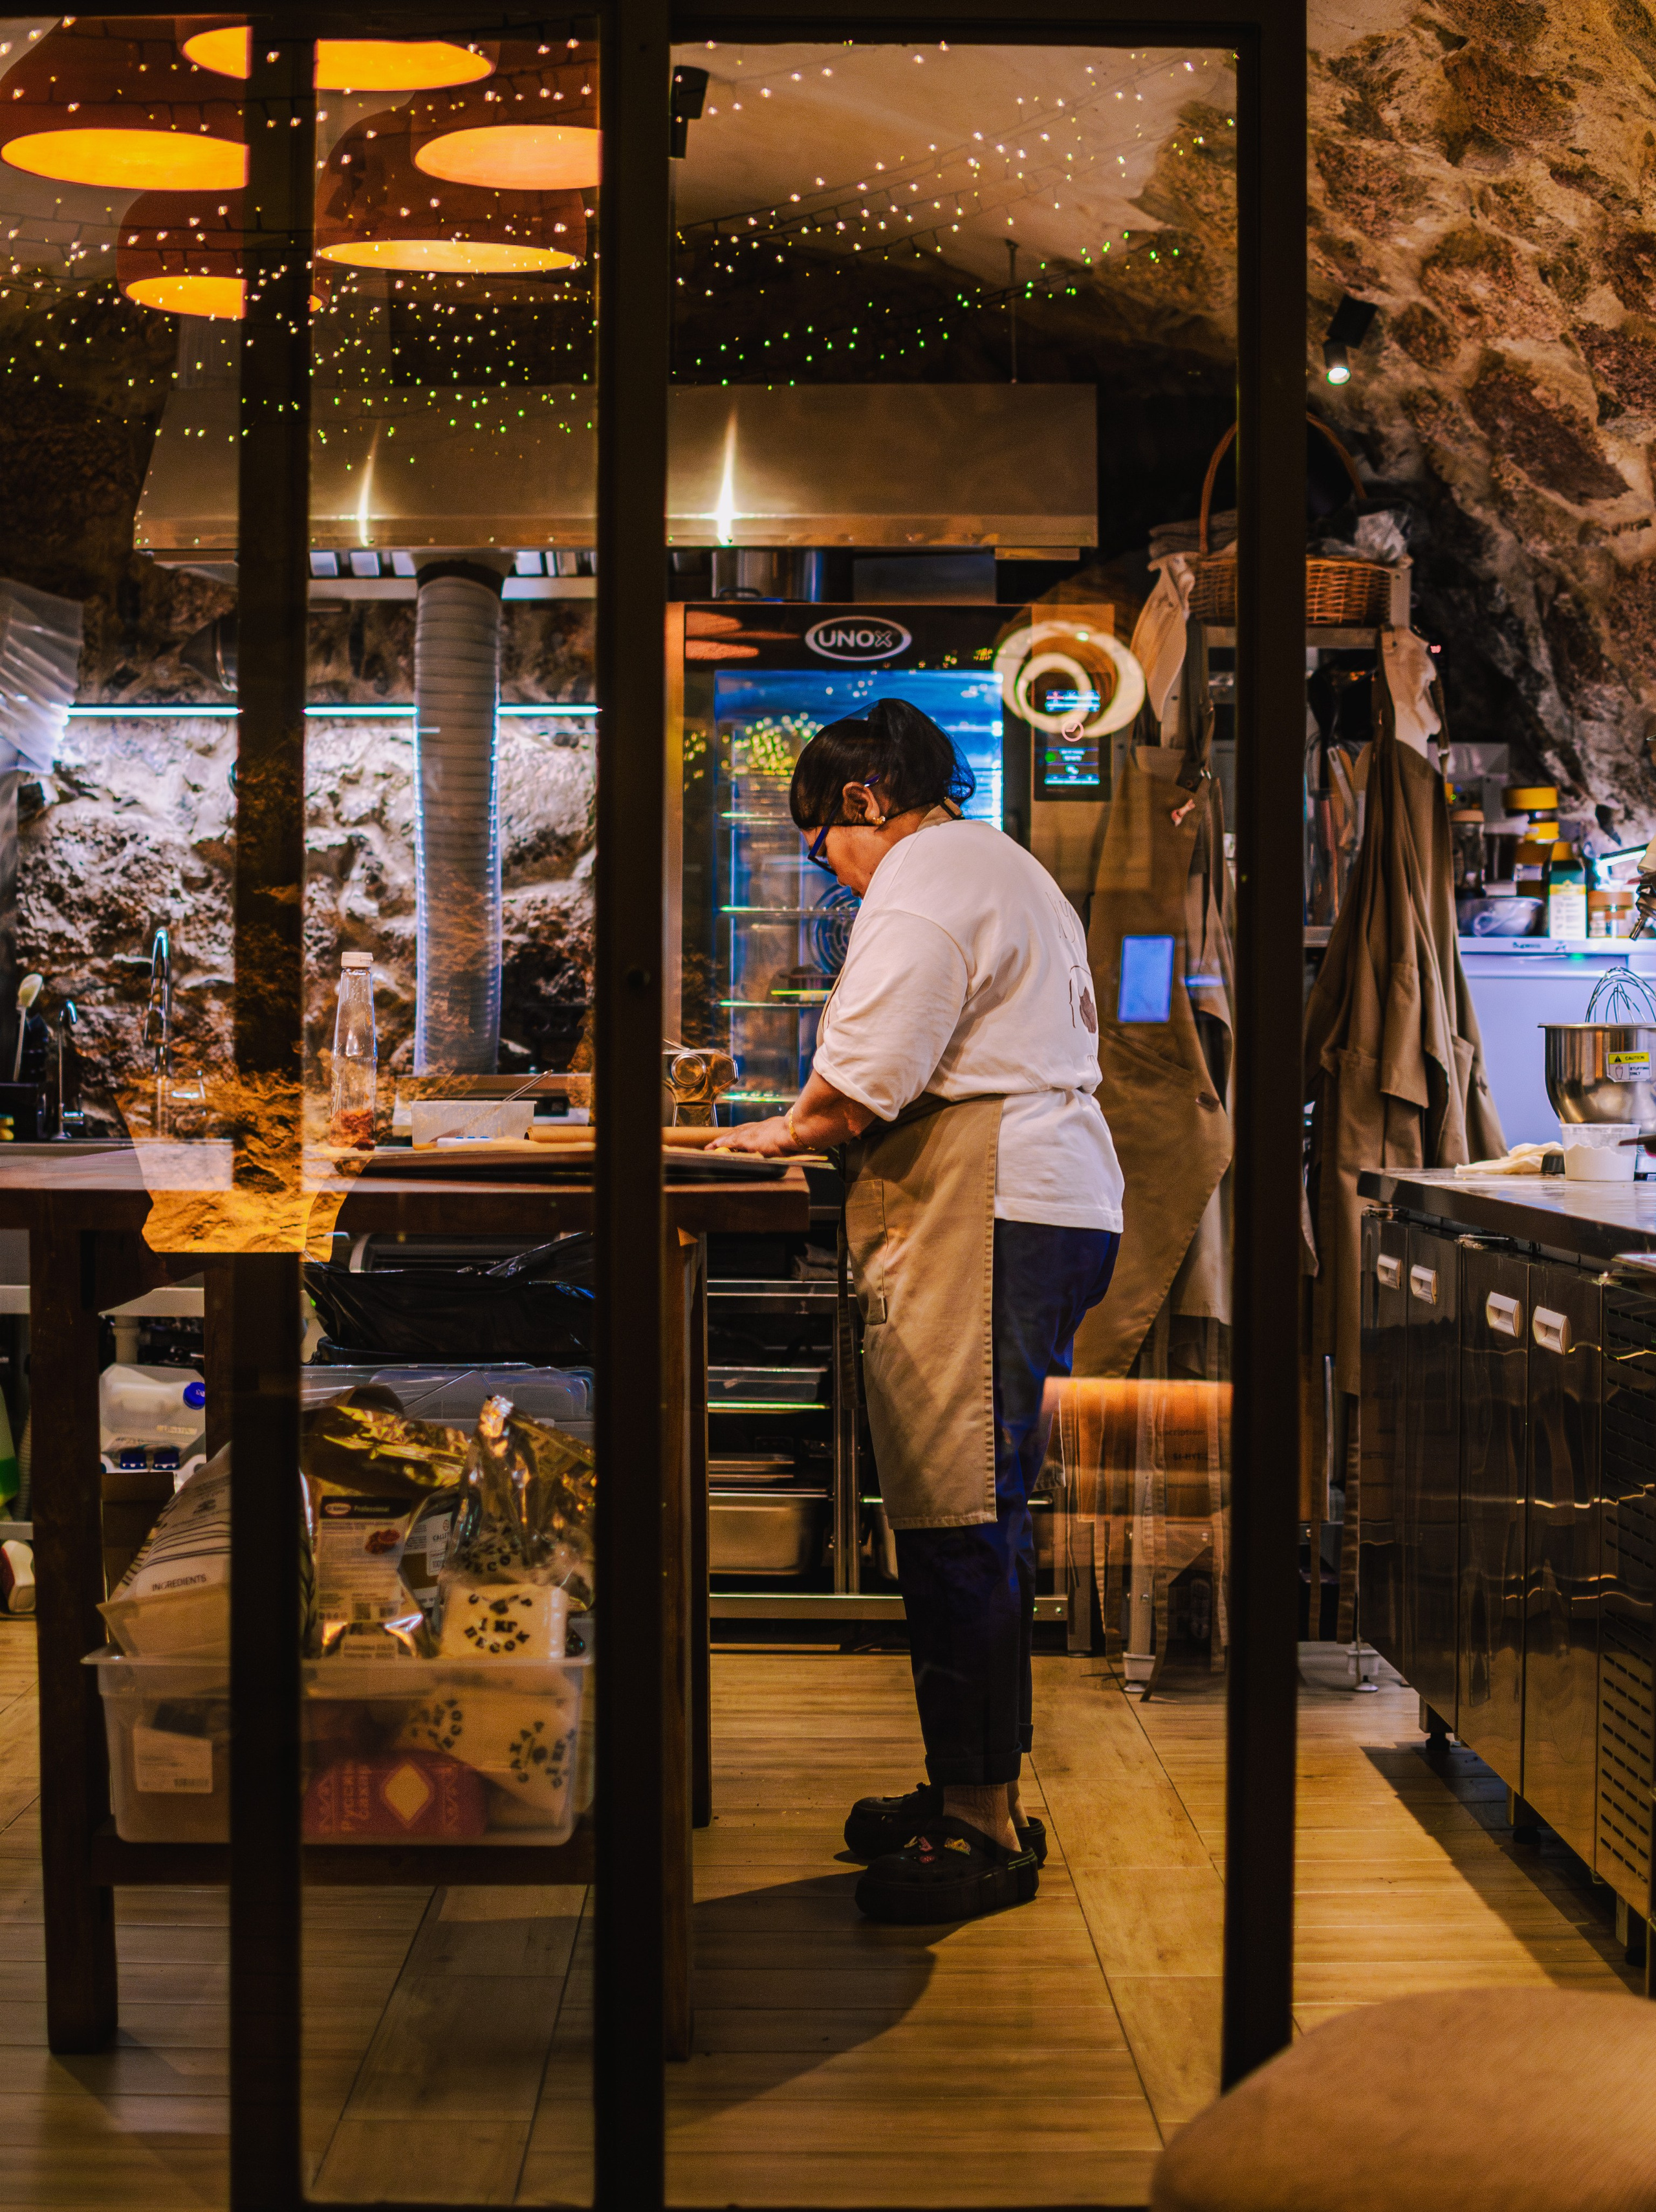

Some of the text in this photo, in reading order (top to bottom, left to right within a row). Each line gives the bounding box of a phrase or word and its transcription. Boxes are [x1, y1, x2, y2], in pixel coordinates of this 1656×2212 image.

[818, 630, 893, 648] UNOX
[152, 1574, 206, 1591] INGREDIENTS
[464, 1626, 530, 1654] ПЕСОК
